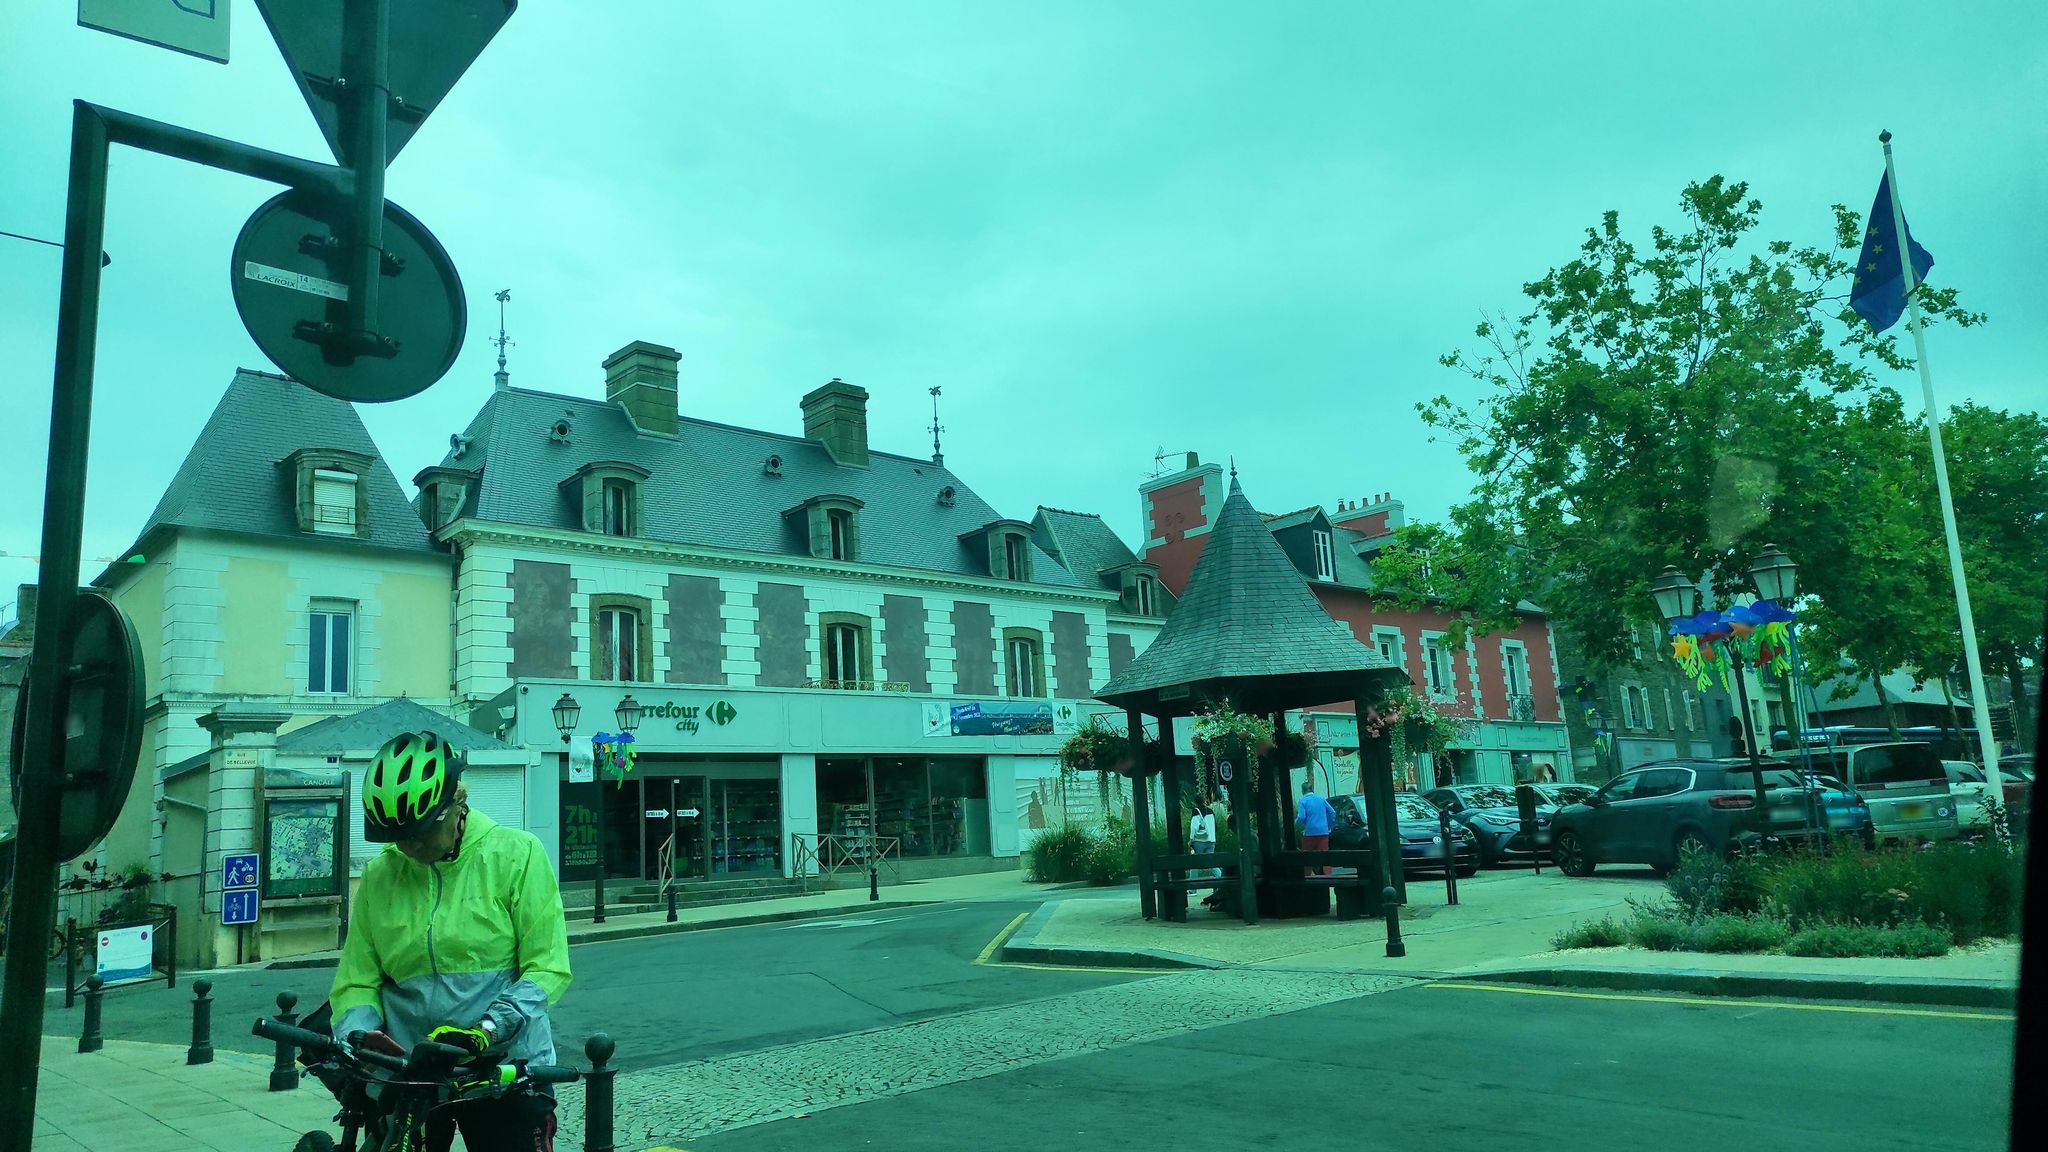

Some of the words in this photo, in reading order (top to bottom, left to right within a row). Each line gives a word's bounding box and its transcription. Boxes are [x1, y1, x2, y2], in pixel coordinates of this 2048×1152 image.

[257, 273, 296, 288] LACROIX
[299, 275, 309, 283] 14
[640, 701, 700, 719] rrefour
[676, 719, 700, 735] city
[565, 805, 591, 824] 7h
